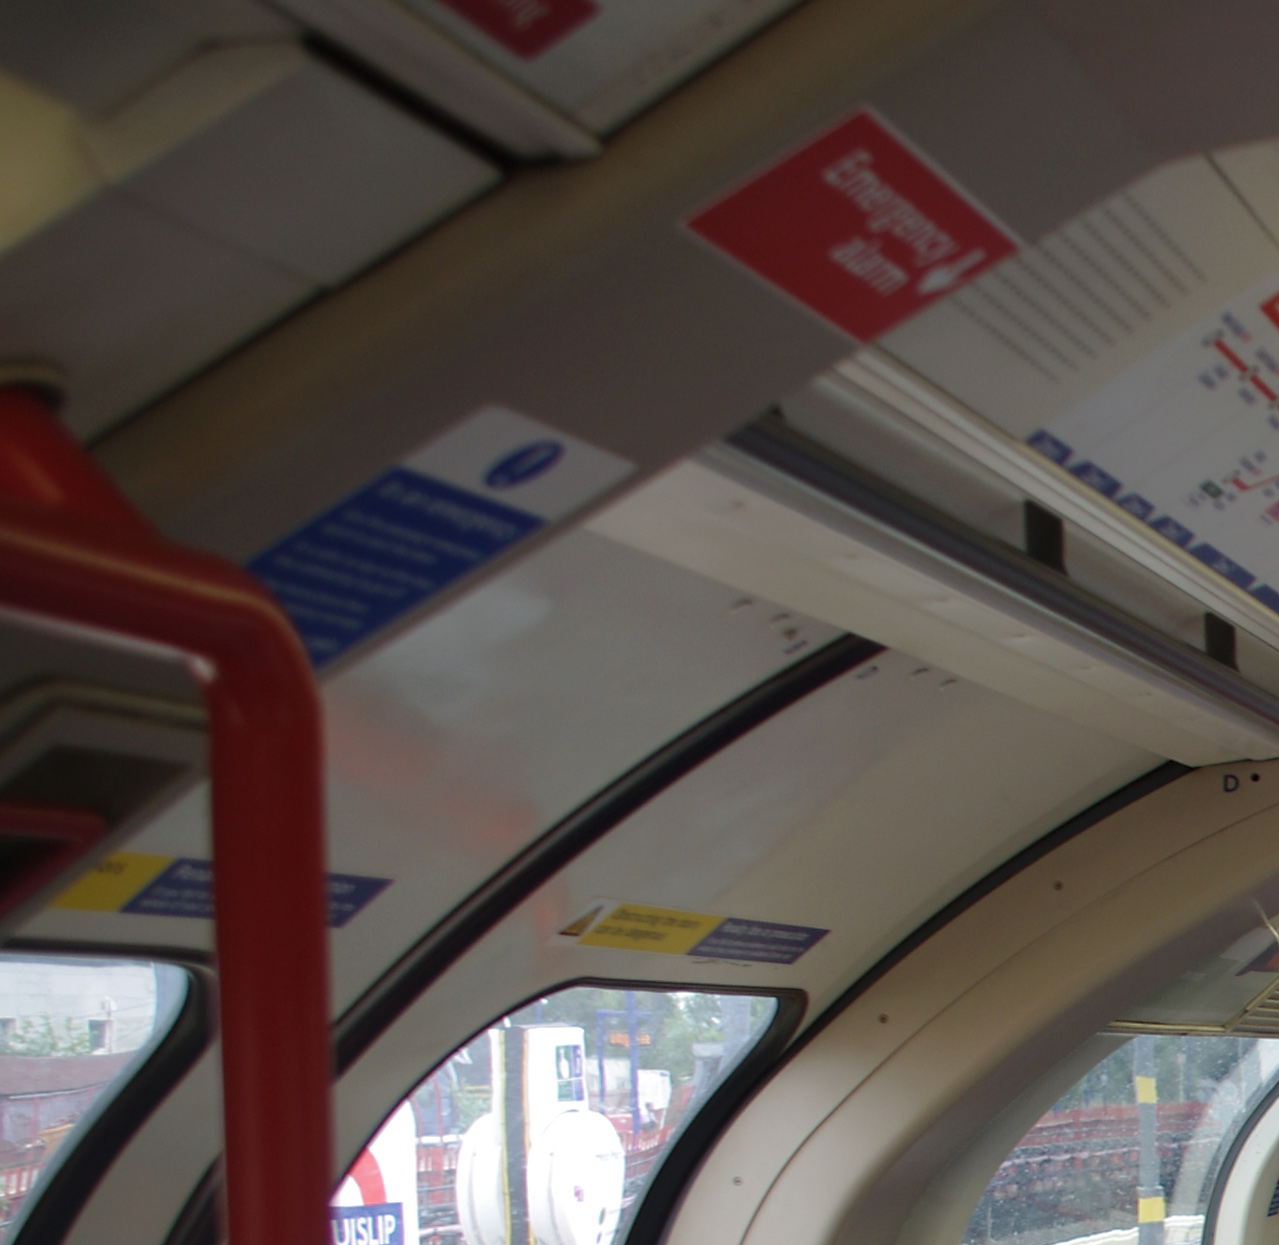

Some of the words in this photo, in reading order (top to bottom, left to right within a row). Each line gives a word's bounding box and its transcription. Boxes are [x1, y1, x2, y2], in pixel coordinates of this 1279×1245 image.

[822, 148, 956, 268] Emergency
[830, 237, 909, 296] alarm
[1223, 774, 1239, 792] D
